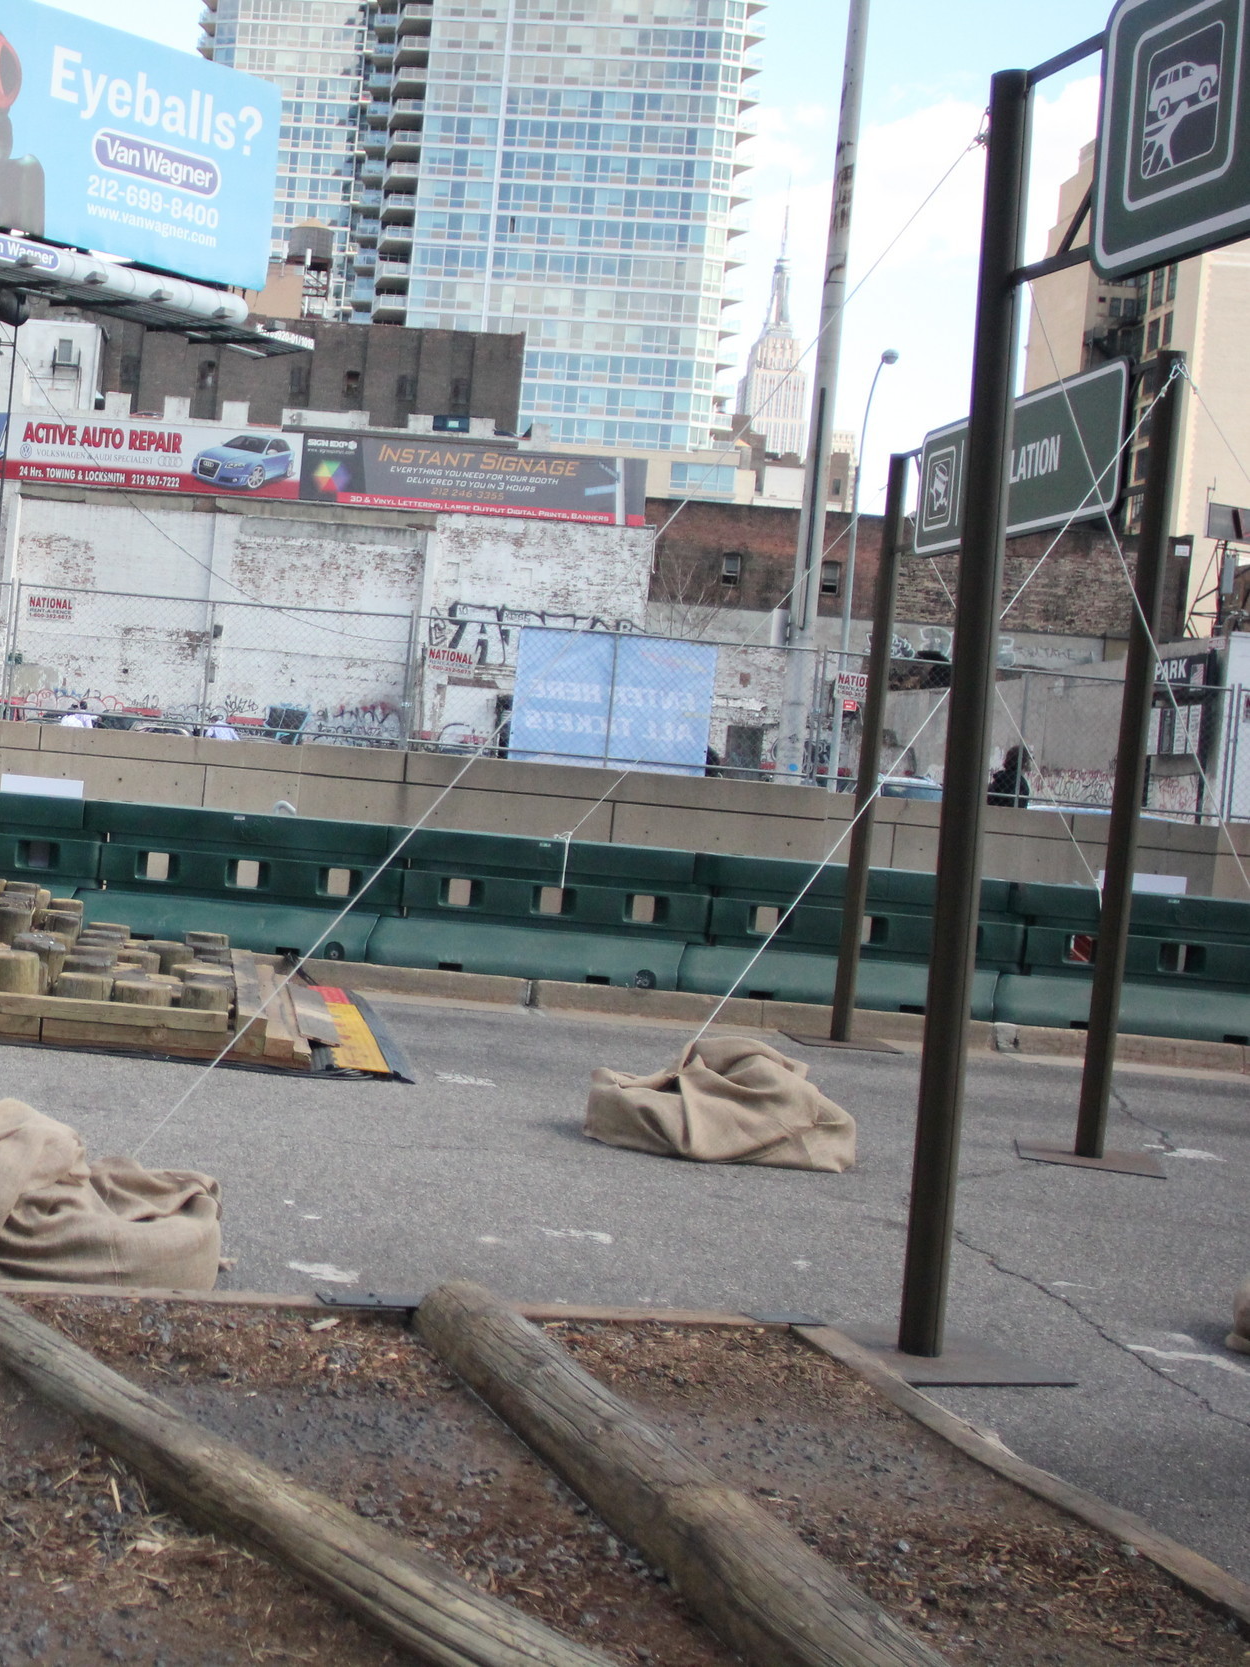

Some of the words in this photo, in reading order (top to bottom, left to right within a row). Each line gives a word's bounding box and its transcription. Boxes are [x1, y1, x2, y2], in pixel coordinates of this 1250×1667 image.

[49, 45, 263, 156] Eyeballs?
[100, 136, 140, 168] Van
[143, 147, 213, 188] Wagner
[87, 175, 219, 229] 212-699-8400
[87, 202, 217, 248] www.vanwagner.com
[23, 422, 77, 445] ACTIVE
[80, 426, 125, 449] AUTO
[129, 429, 183, 454] REPAIR
[36, 448, 87, 460] VOLKSWAGEN
[94, 453, 112, 462] AUDI
[113, 455, 153, 465] SPECIALIST
[378, 444, 476, 468] INSTANT
[479, 452, 581, 476] SIGNAGE
[1009, 434, 1061, 484] LATION
[19, 465, 28, 477] 24
[30, 466, 44, 478] Hrs.
[46, 467, 76, 480] TOWING
[77, 470, 83, 480] &
[85, 471, 126, 484] LOCKSMITH
[131, 474, 145, 486] 212
[147, 475, 180, 488] 967-7222
[390, 466, 443, 477] EVERYTHING
[444, 470, 460, 478] YOU
[462, 471, 485, 480] NEED
[486, 473, 503, 481] FOR
[505, 475, 528, 483] YOUR
[529, 477, 560, 485] BOOTH
[406, 476, 453, 487] DELIVERED
[455, 480, 467, 488] TO
[469, 481, 486, 489] YOU
[497, 482, 505, 491] 3
[505, 484, 536, 493] HOURS
[373, 497, 397, 506] VINYL
[30, 596, 72, 610] NATIONAL
[429, 648, 473, 665] NATIONAL
[838, 672, 868, 688] NATIO
[1154, 659, 1188, 681] PARK
